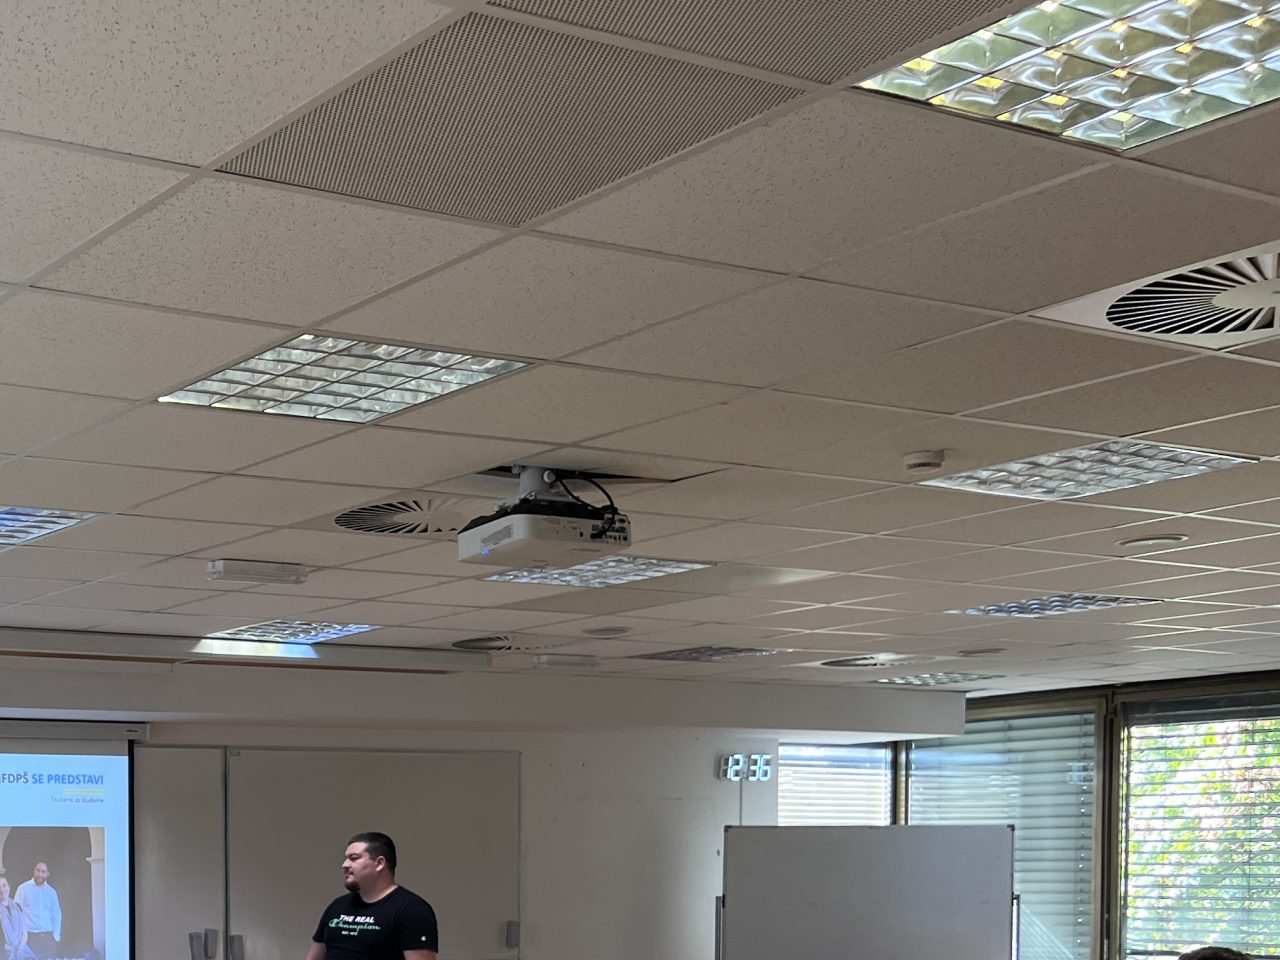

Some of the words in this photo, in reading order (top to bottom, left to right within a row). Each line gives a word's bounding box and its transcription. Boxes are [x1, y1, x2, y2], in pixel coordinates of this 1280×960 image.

[31, 773, 44, 784] SE
[47, 774, 104, 785] PREDSTAVI
[339, 914, 355, 922] THE
